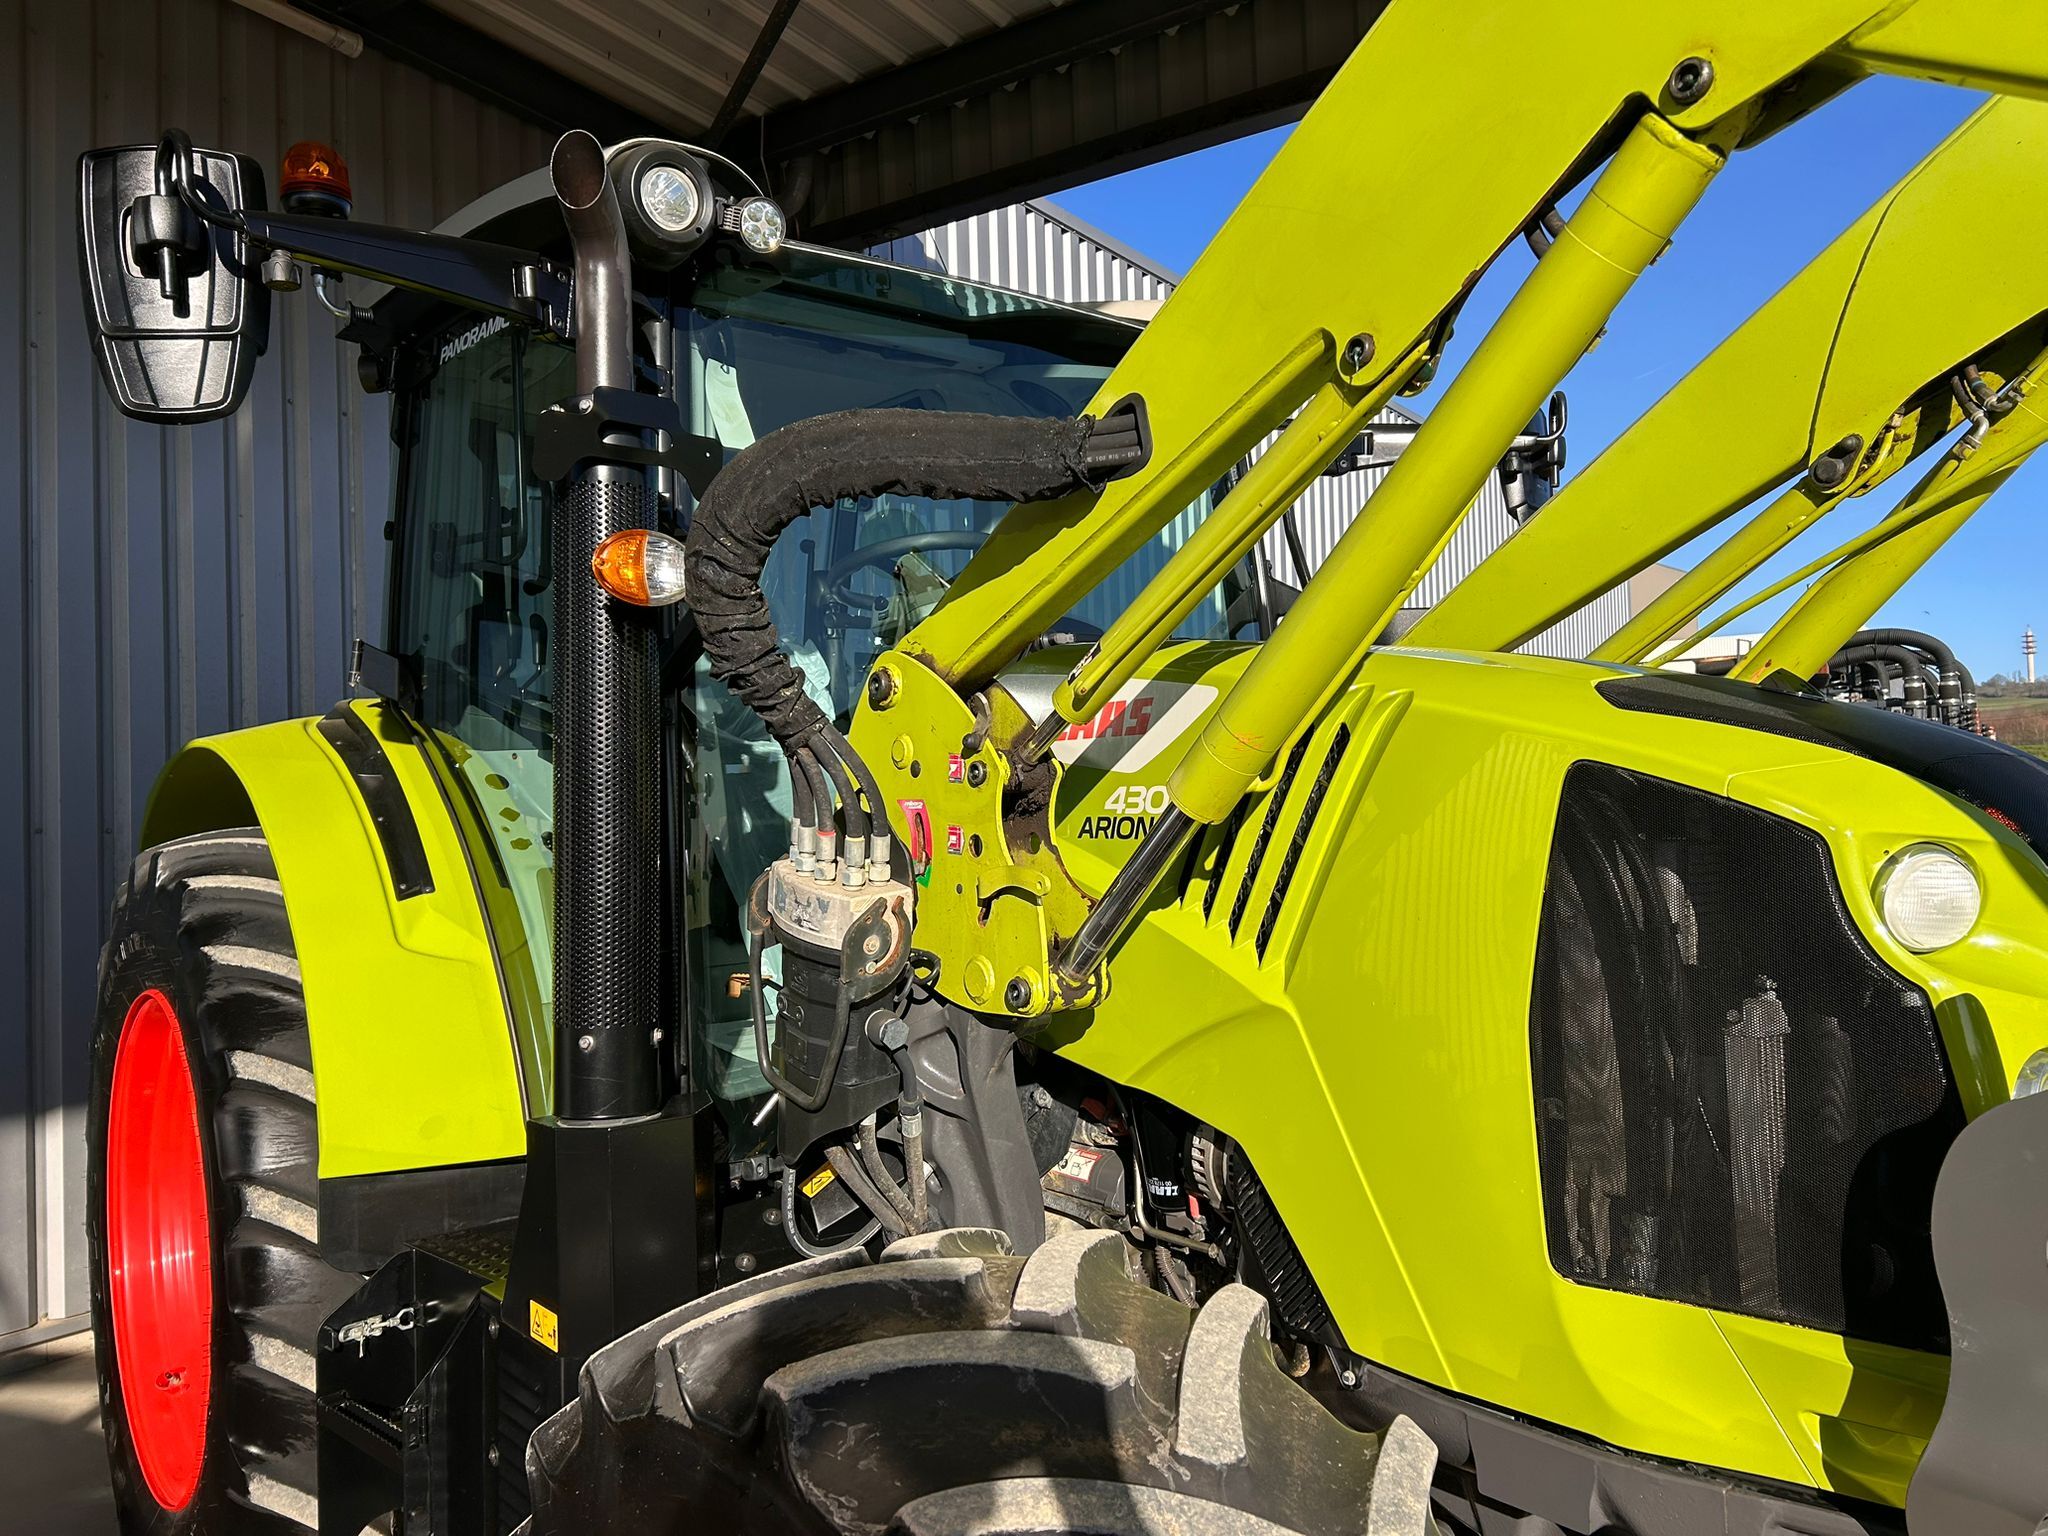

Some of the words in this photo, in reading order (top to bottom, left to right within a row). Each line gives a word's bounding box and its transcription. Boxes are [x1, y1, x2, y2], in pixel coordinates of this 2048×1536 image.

[1056, 697, 1154, 741] AAS
[1104, 785, 1170, 814] 430
[1077, 816, 1155, 840] ARION
